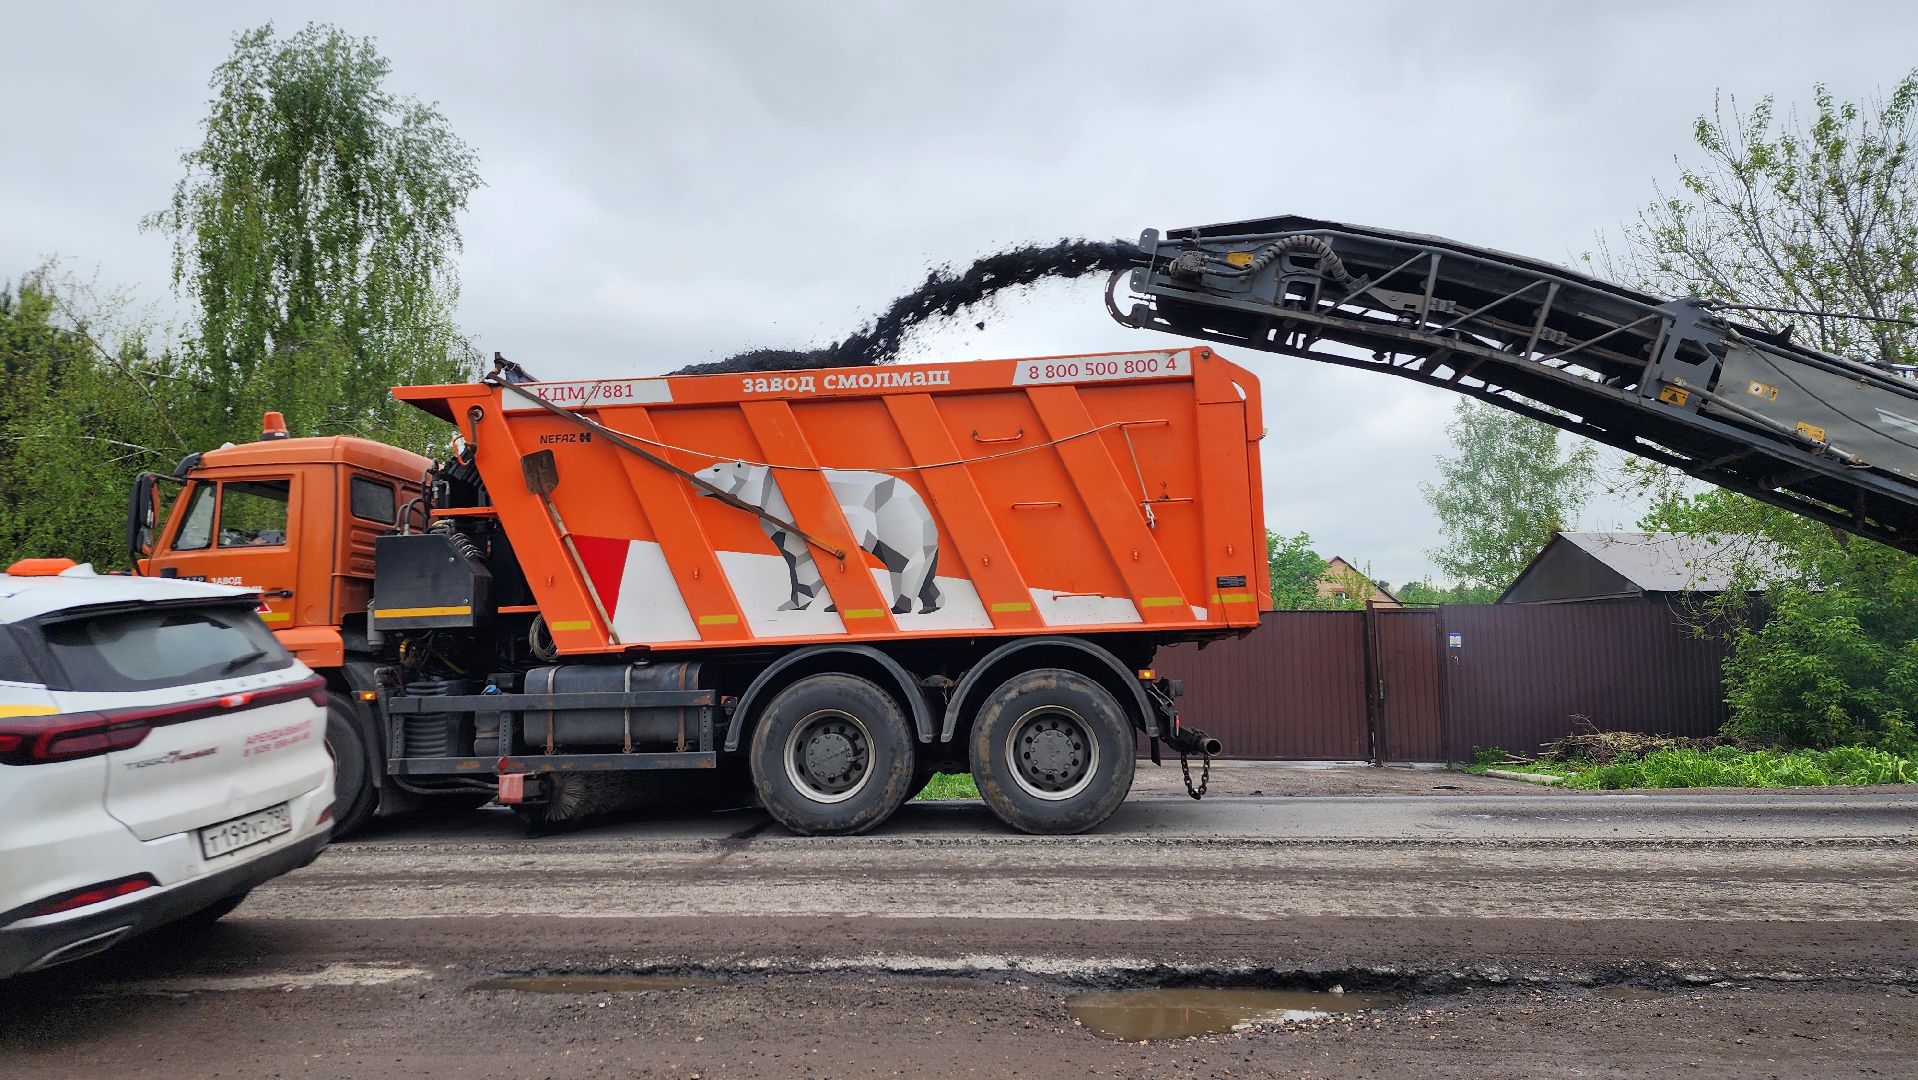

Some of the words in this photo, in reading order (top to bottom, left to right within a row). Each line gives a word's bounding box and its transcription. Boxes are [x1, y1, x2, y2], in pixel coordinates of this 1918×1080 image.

[1029, 366, 1039, 379] 8
[1045, 364, 1079, 378] 800
[1085, 361, 1118, 375] 500
[1124, 358, 1158, 373] 800
[1165, 357, 1177, 371] 4
[537, 386, 585, 402] КДМ
[592, 384, 634, 399] 7881
[540, 433, 576, 444] NEFAZ
